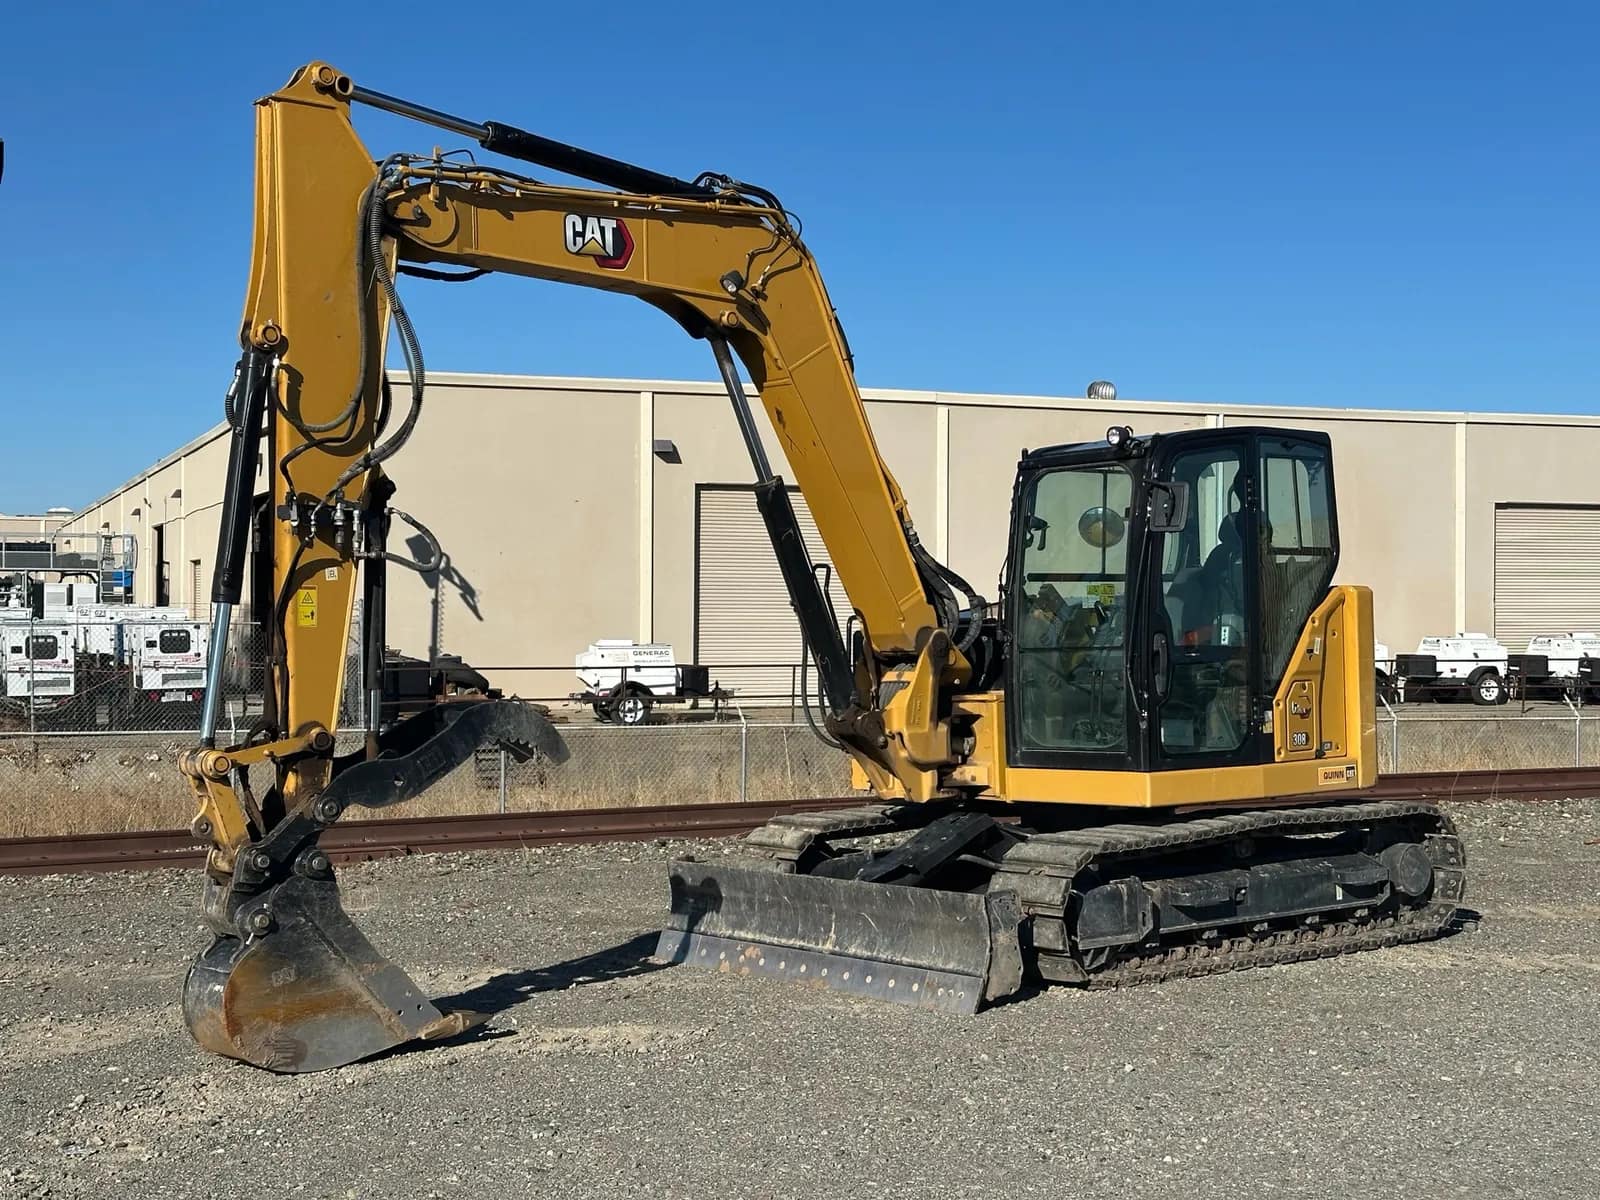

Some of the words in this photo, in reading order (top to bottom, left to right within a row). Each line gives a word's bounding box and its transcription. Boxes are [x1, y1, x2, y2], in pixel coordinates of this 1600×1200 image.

[565, 214, 616, 257] CAT
[1292, 733, 1307, 745] 308
[1323, 770, 1344, 780] QUINN
